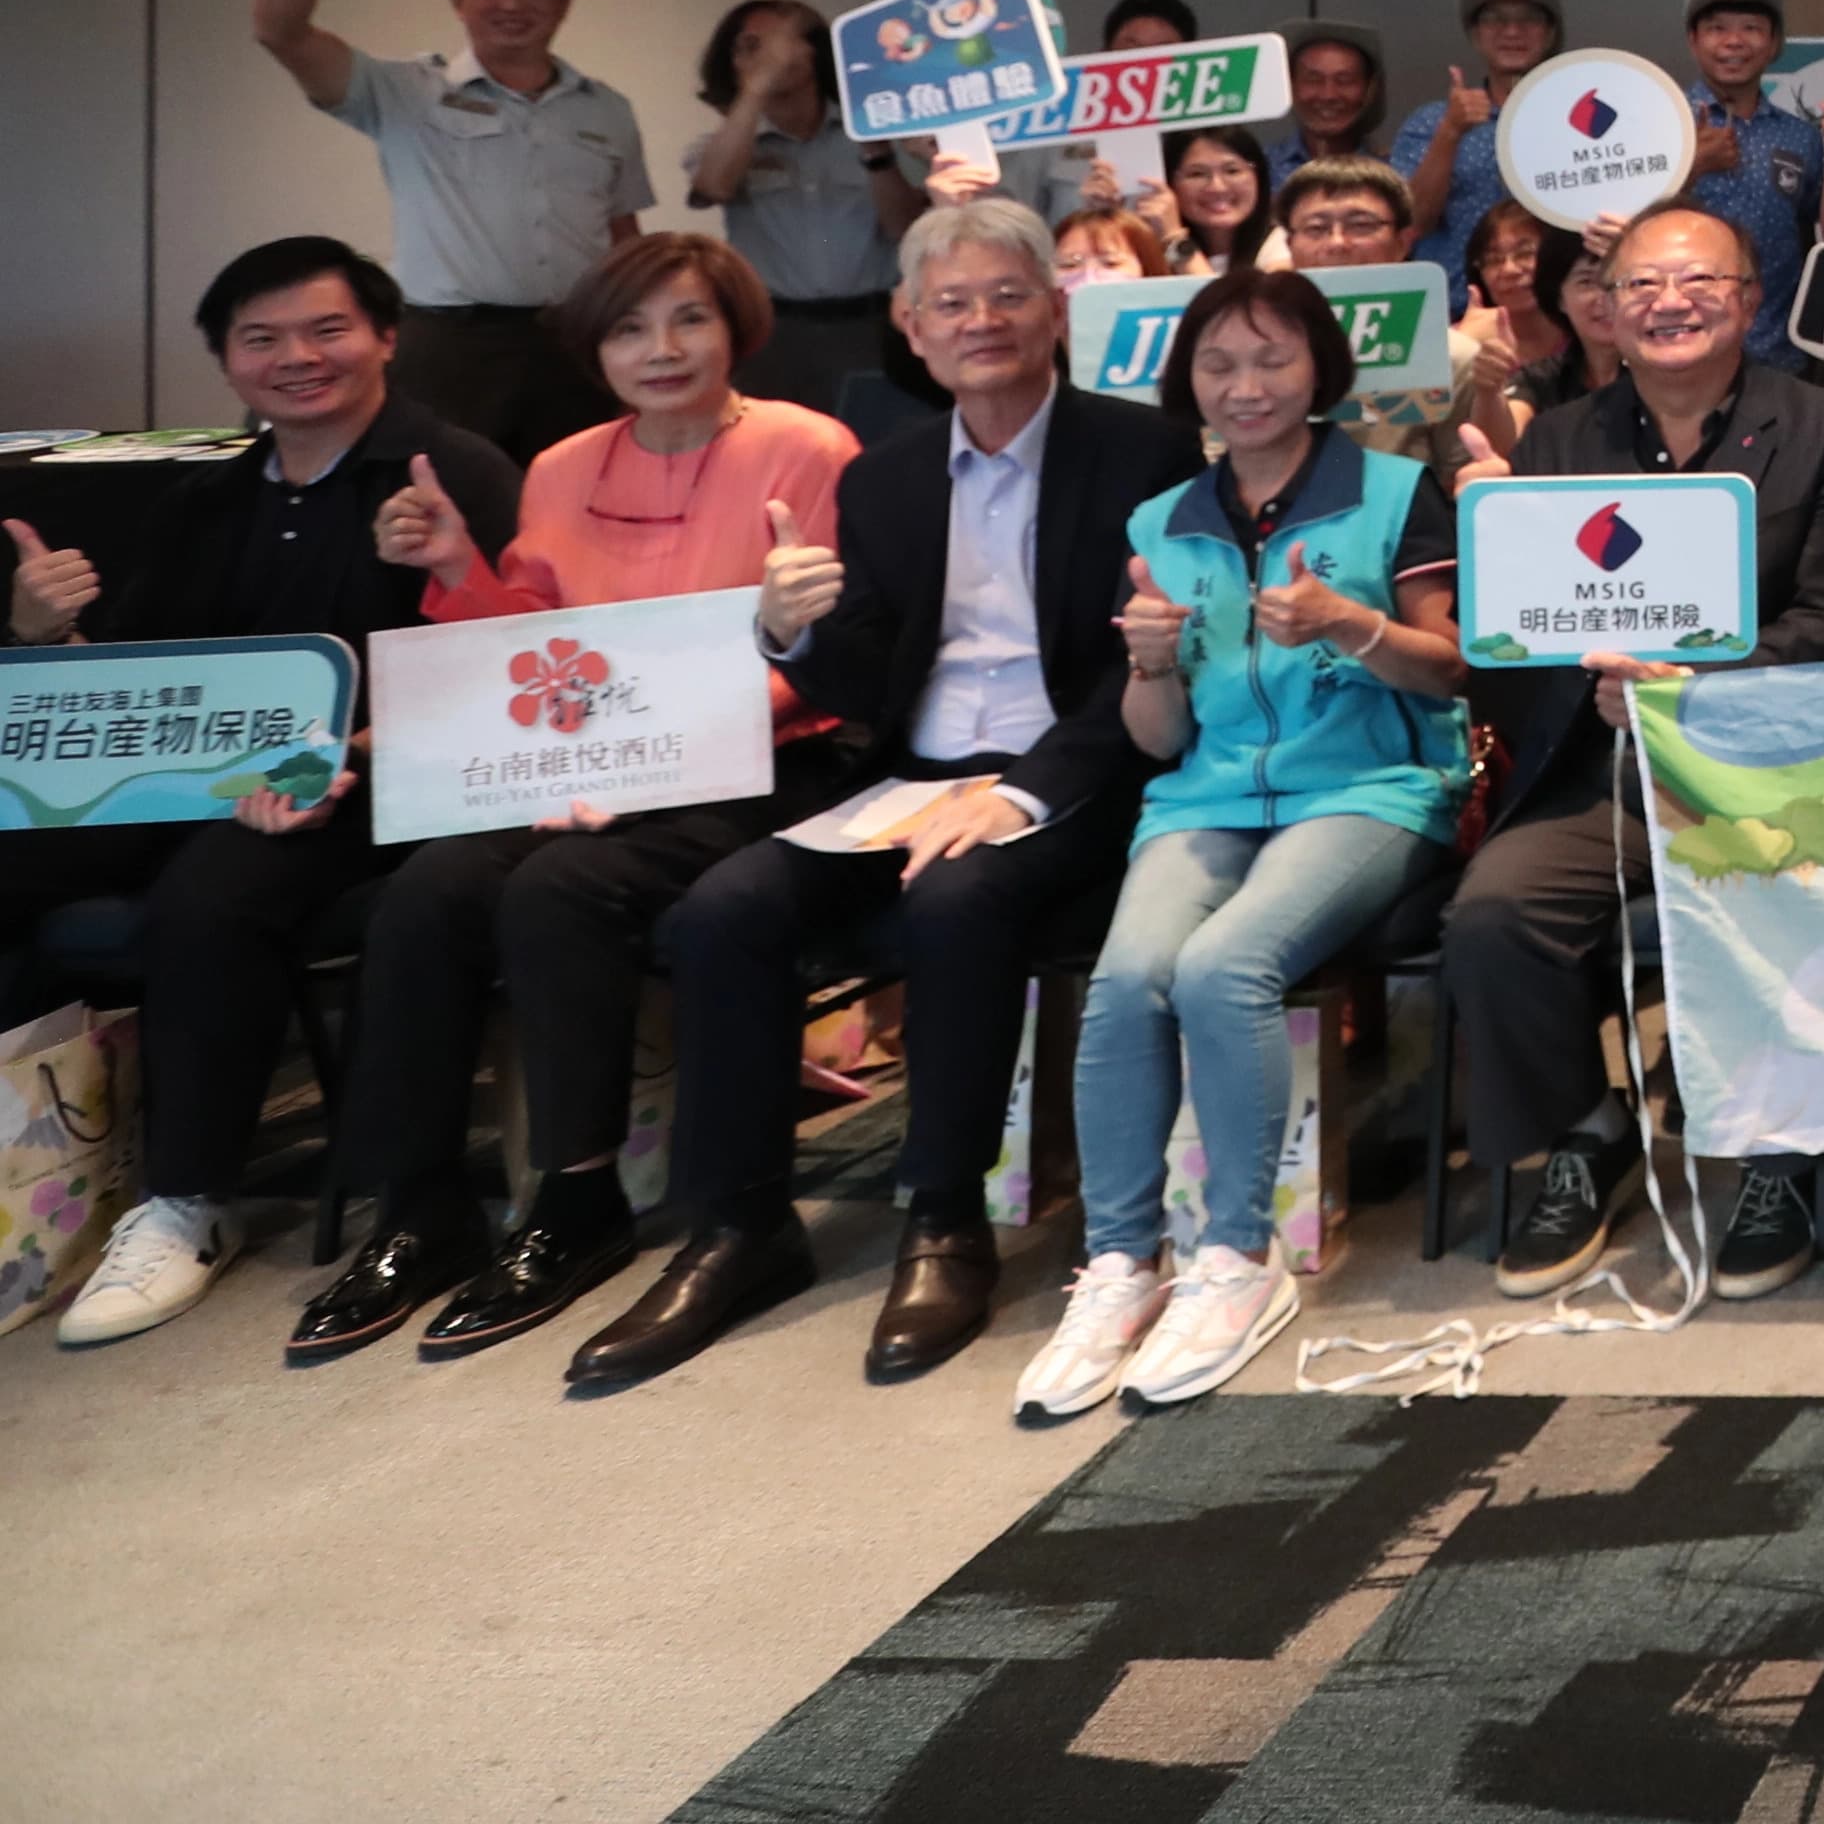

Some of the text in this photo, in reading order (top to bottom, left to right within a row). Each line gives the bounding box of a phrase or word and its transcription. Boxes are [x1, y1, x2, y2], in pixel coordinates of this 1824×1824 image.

[863, 62, 1037, 129] 食魚體驗
[1573, 143, 1626, 163] MSIG
[1575, 581, 1646, 600] MSIG
[8, 685, 204, 714] 三井住友海上集團
[461, 733, 684, 788] 台南維悅酒店
